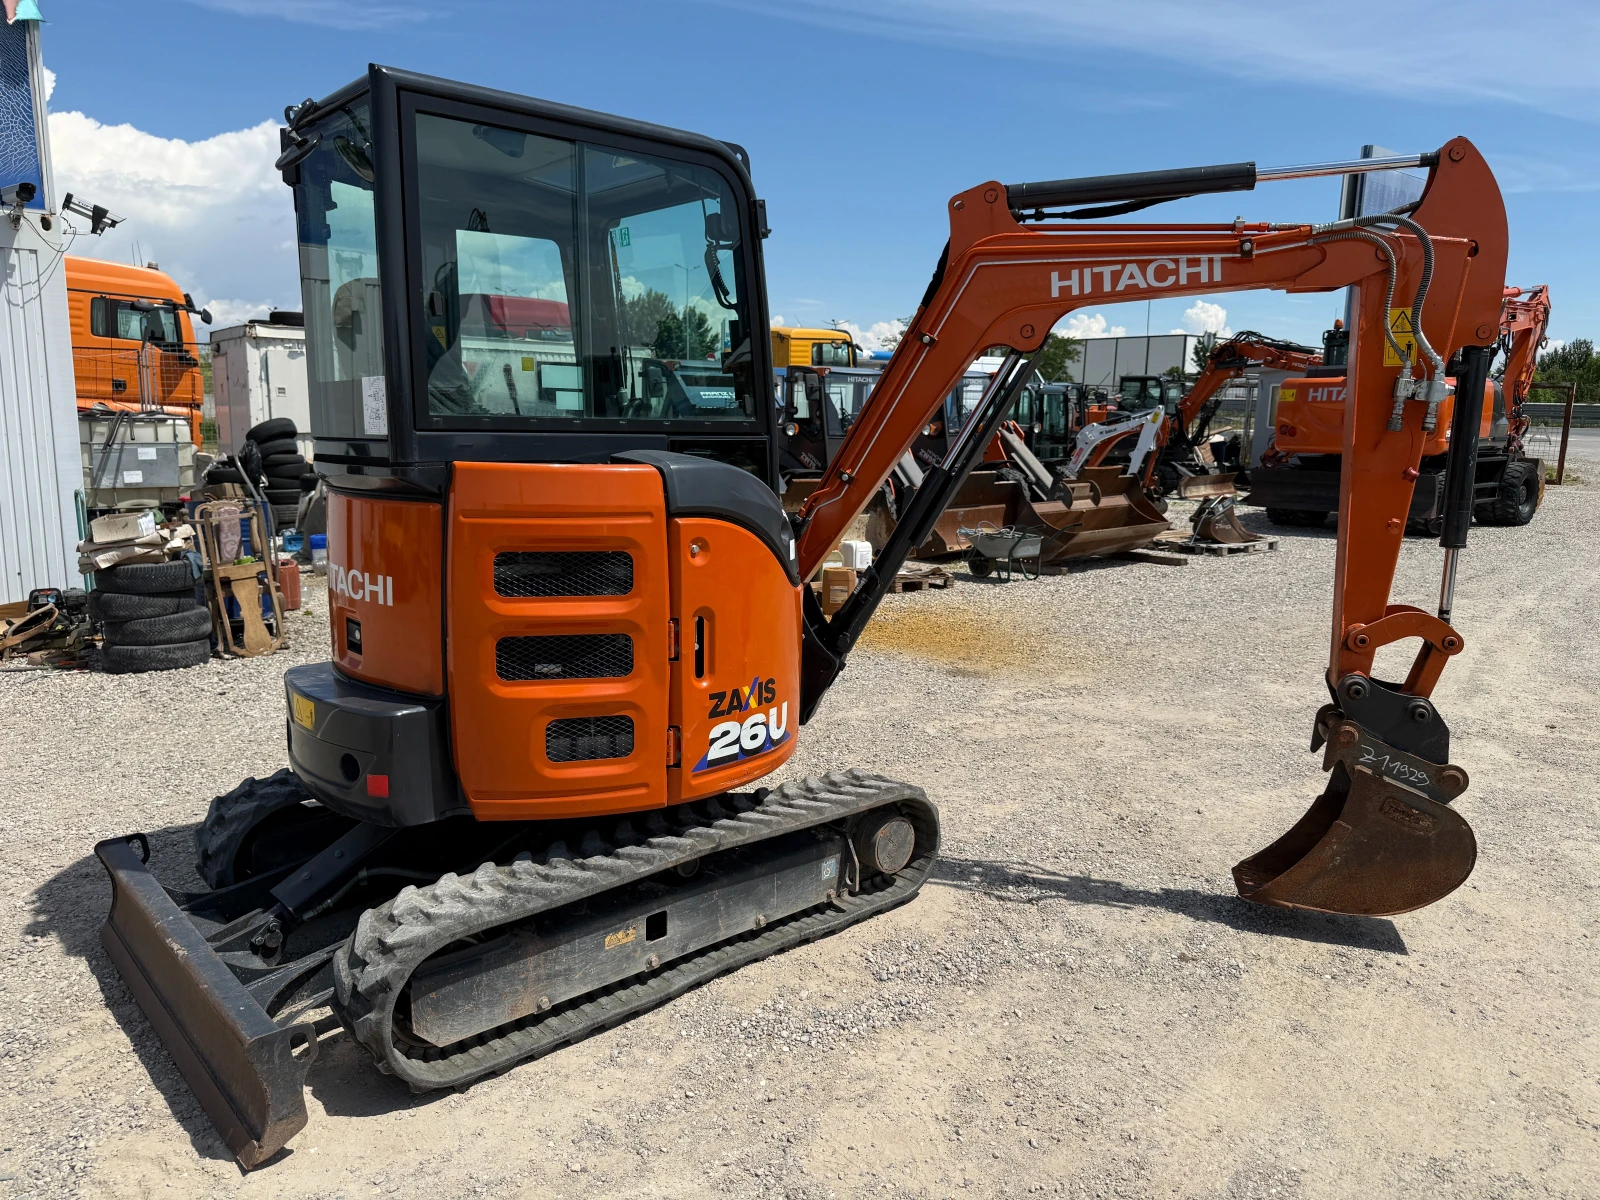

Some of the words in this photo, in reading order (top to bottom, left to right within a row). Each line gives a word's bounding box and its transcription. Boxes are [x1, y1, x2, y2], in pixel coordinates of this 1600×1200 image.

[1051, 256, 1222, 298] HITACHI
[1291, 361, 1307, 369] HITAC
[708, 676, 777, 720] ZAXIS
[706, 700, 788, 768] 26U
